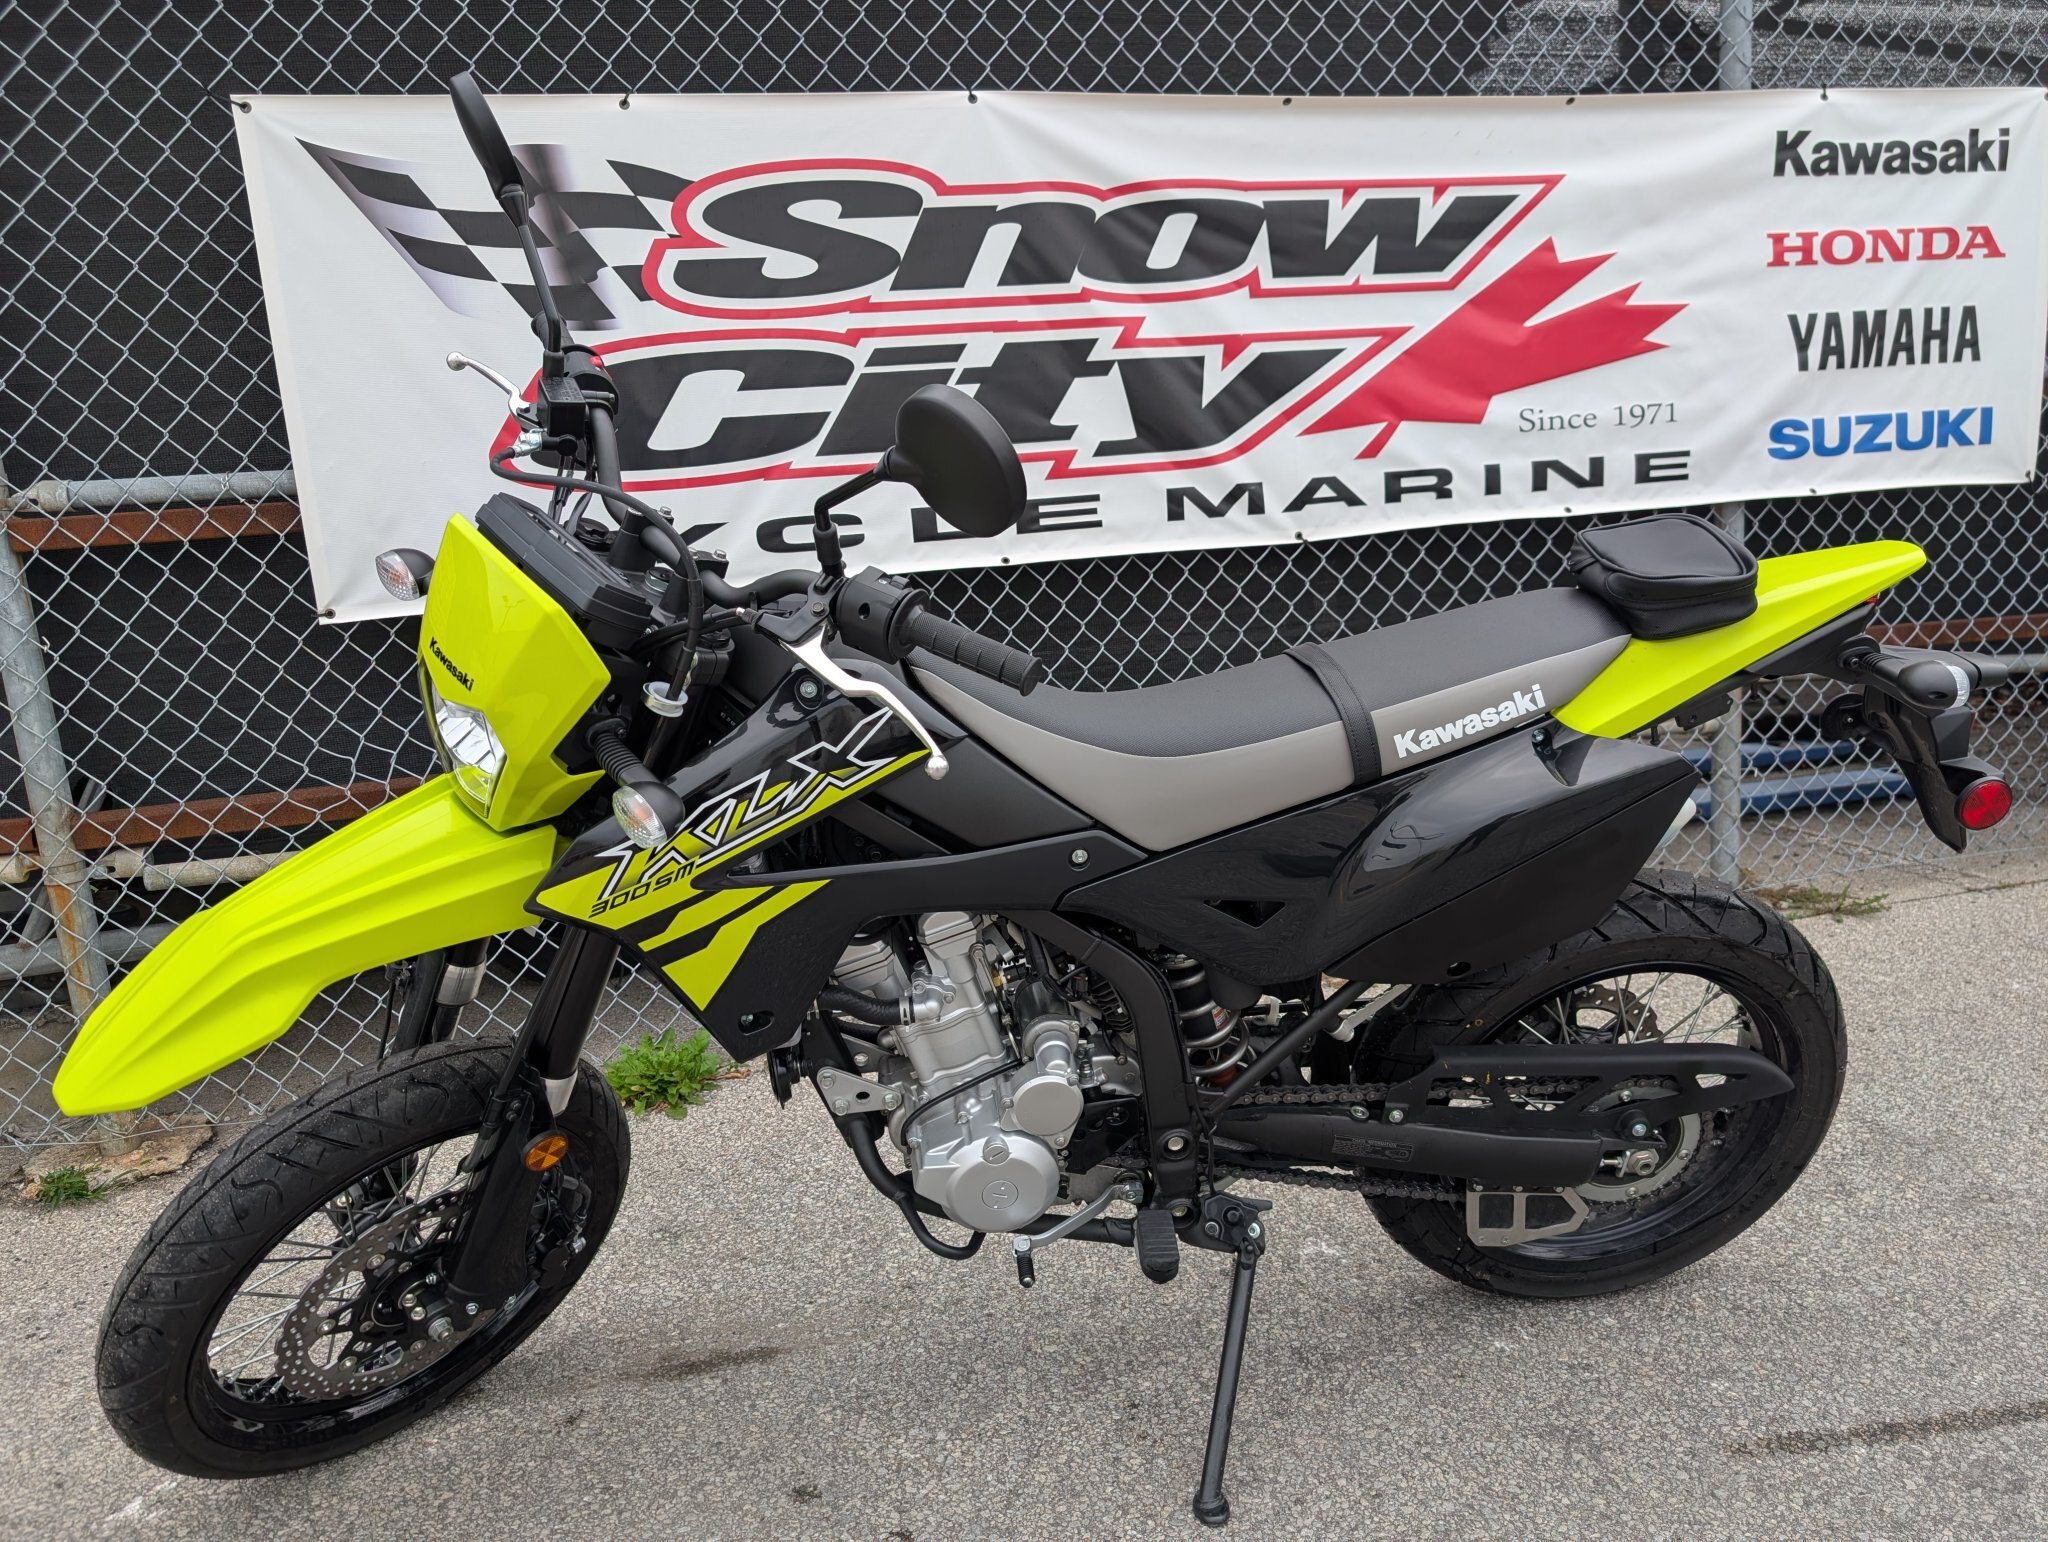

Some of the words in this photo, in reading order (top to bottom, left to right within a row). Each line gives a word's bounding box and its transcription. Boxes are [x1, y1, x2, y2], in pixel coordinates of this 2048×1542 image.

[1773, 127, 2010, 177] Kawasaki
[673, 180, 1521, 299] Snow
[1766, 225, 2006, 268] HONDA
[1787, 305, 1981, 372] YAMAHA
[531, 338, 1348, 471] City
[1518, 407, 1598, 433] Since
[1613, 402, 1678, 429] 1971
[1767, 406, 1994, 461] SUZUKI
[680, 493, 1103, 553] CLE
[1166, 450, 1692, 522] MARINE
[429, 636, 475, 691] Kawasaki
[1393, 683, 1546, 758] Kawasaki
